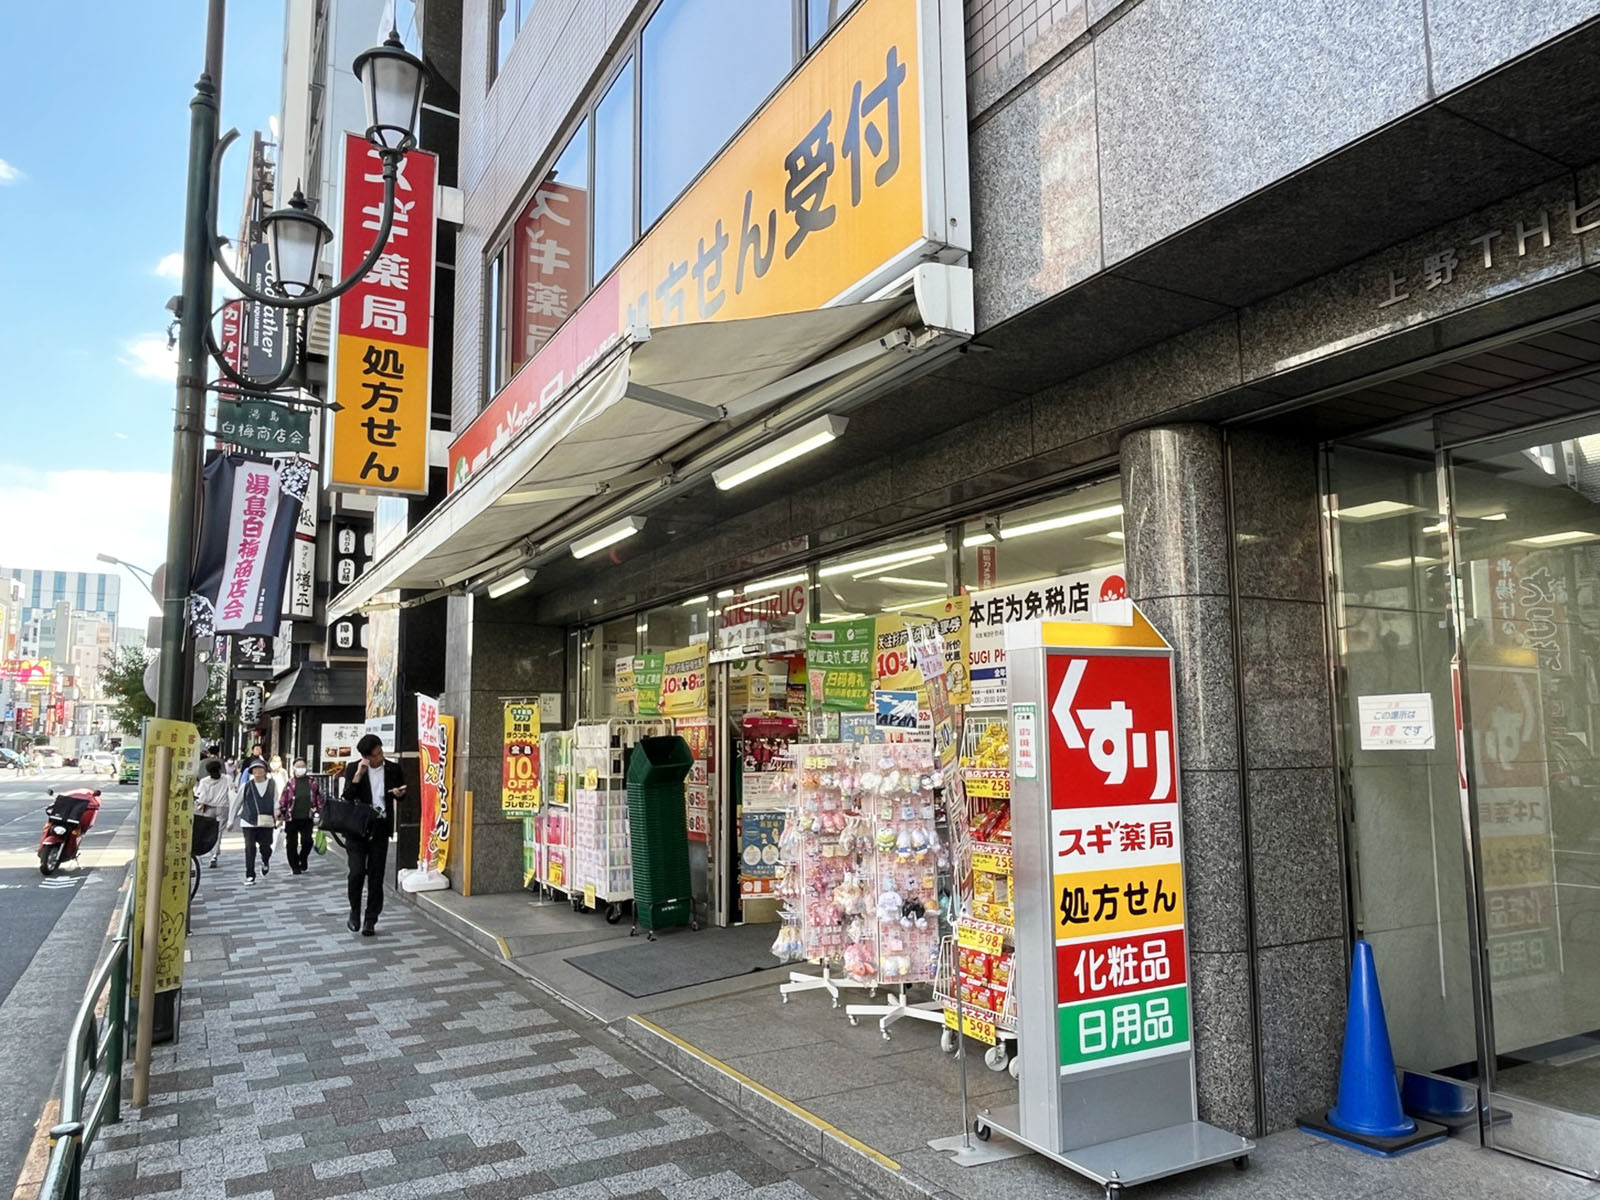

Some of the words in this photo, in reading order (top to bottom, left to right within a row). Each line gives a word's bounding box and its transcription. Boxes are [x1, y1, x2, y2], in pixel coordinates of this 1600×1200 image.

[360, 148, 414, 336] スギ薬局
[222, 421, 304, 444] 白梅商店会
[360, 345, 404, 482] 処方せん
[222, 472, 270, 620] 湯島白梅商店会
[968, 581, 1090, 629] 本店为免税店
[969, 650, 990, 666] SUGI
[1052, 659, 1171, 801] くすり
[507, 780, 534, 789] OFF
[992, 780, 1011, 791] 258
[1058, 819, 1174, 858] スギ薬局
[1060, 879, 1177, 926] 処方せん
[978, 933, 999, 948] 598
[1074, 938, 1170, 994] 化粧品
[969, 1021, 990, 1036] 598
[1078, 998, 1174, 1055] 日用品
